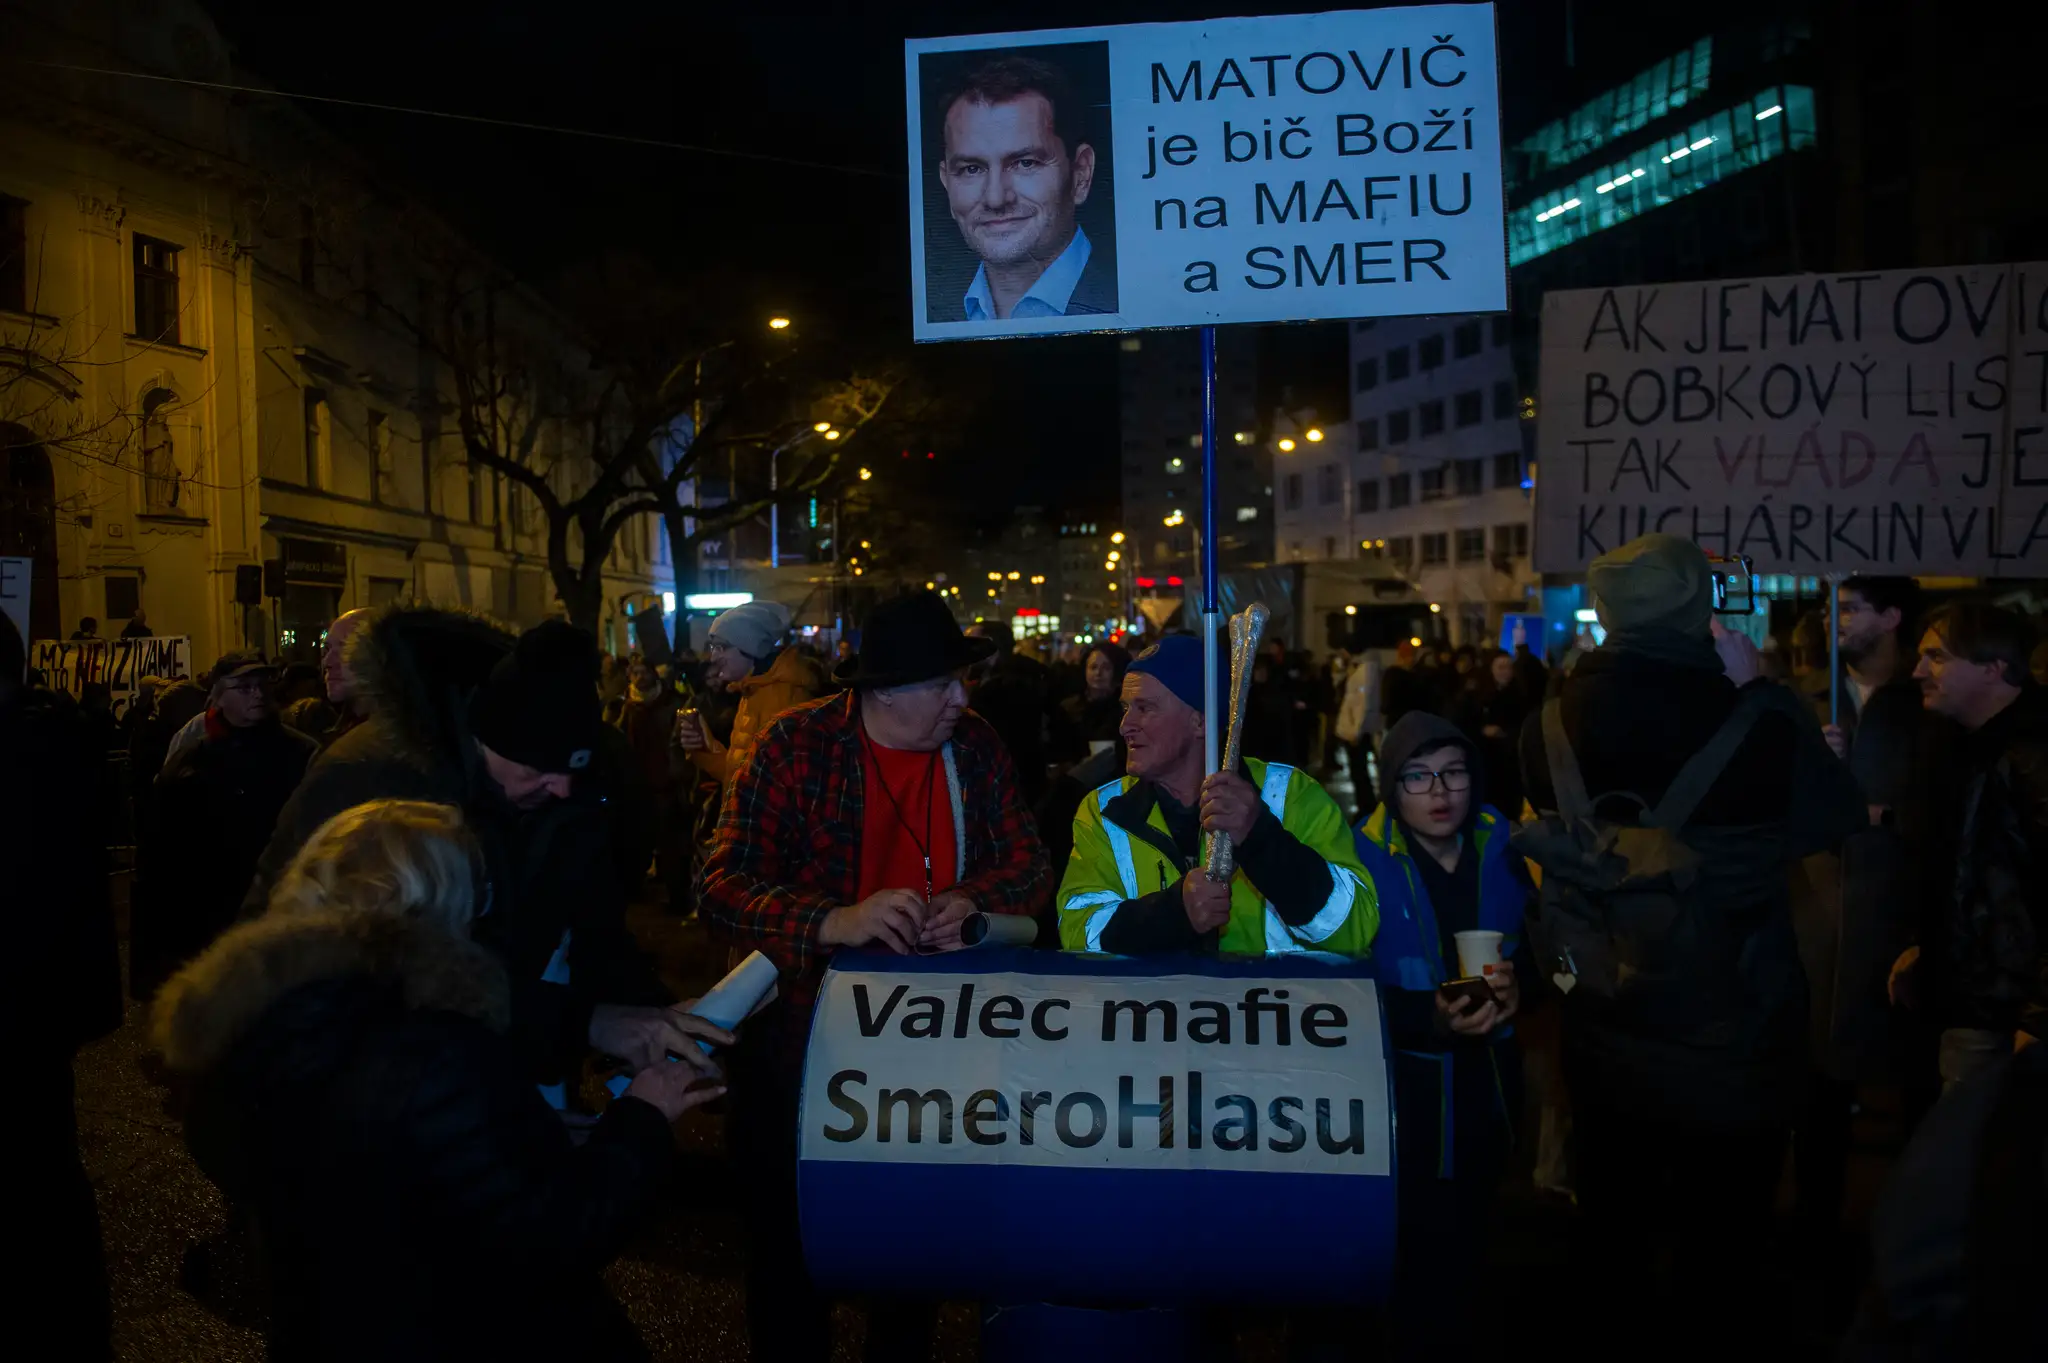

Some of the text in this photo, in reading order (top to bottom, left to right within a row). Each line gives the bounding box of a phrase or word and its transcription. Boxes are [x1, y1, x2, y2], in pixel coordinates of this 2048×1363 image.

[1151, 34, 1467, 103] MATOVIČ
[1142, 108, 1475, 179] je bič Boží
[1155, 172, 1472, 230] na MAFIU
[1183, 238, 1452, 293] a SMER
[1583, 289, 1666, 353] AK
[1584, 353, 1878, 428] BOBKOVÝ
[1567, 422, 2048, 493] TAK VLÁDA JE
[852, 983, 1348, 1047] Valec mafie
[823, 1069, 1365, 1155] SmeroHlasu
